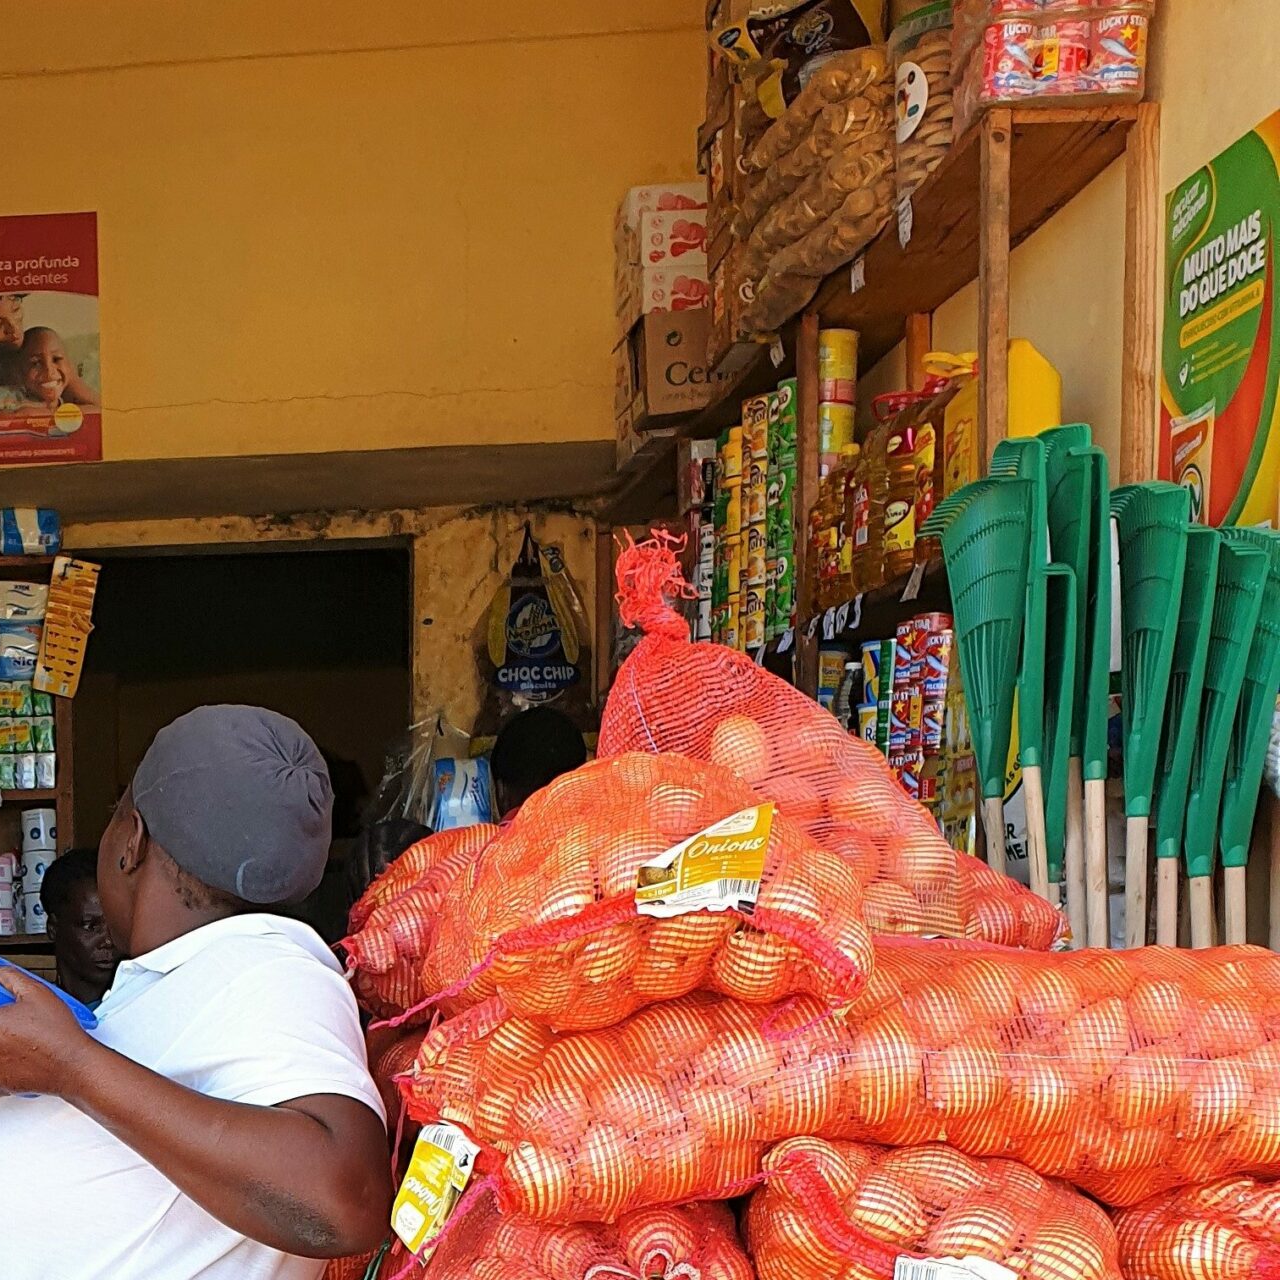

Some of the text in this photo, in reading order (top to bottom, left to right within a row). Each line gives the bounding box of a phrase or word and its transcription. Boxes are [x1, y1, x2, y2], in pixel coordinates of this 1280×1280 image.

[1183, 209, 1262, 286] MUITO MAIS
[15, 255, 80, 273] profunda
[4, 275, 19, 286] os
[23, 272, 69, 286] dentes
[1179, 241, 1266, 319] DO QUE DOCE
[497, 665, 575, 682] CHOC CHIP
[865, 729, 876, 741] Ra
[688, 835, 766, 859] Onions
